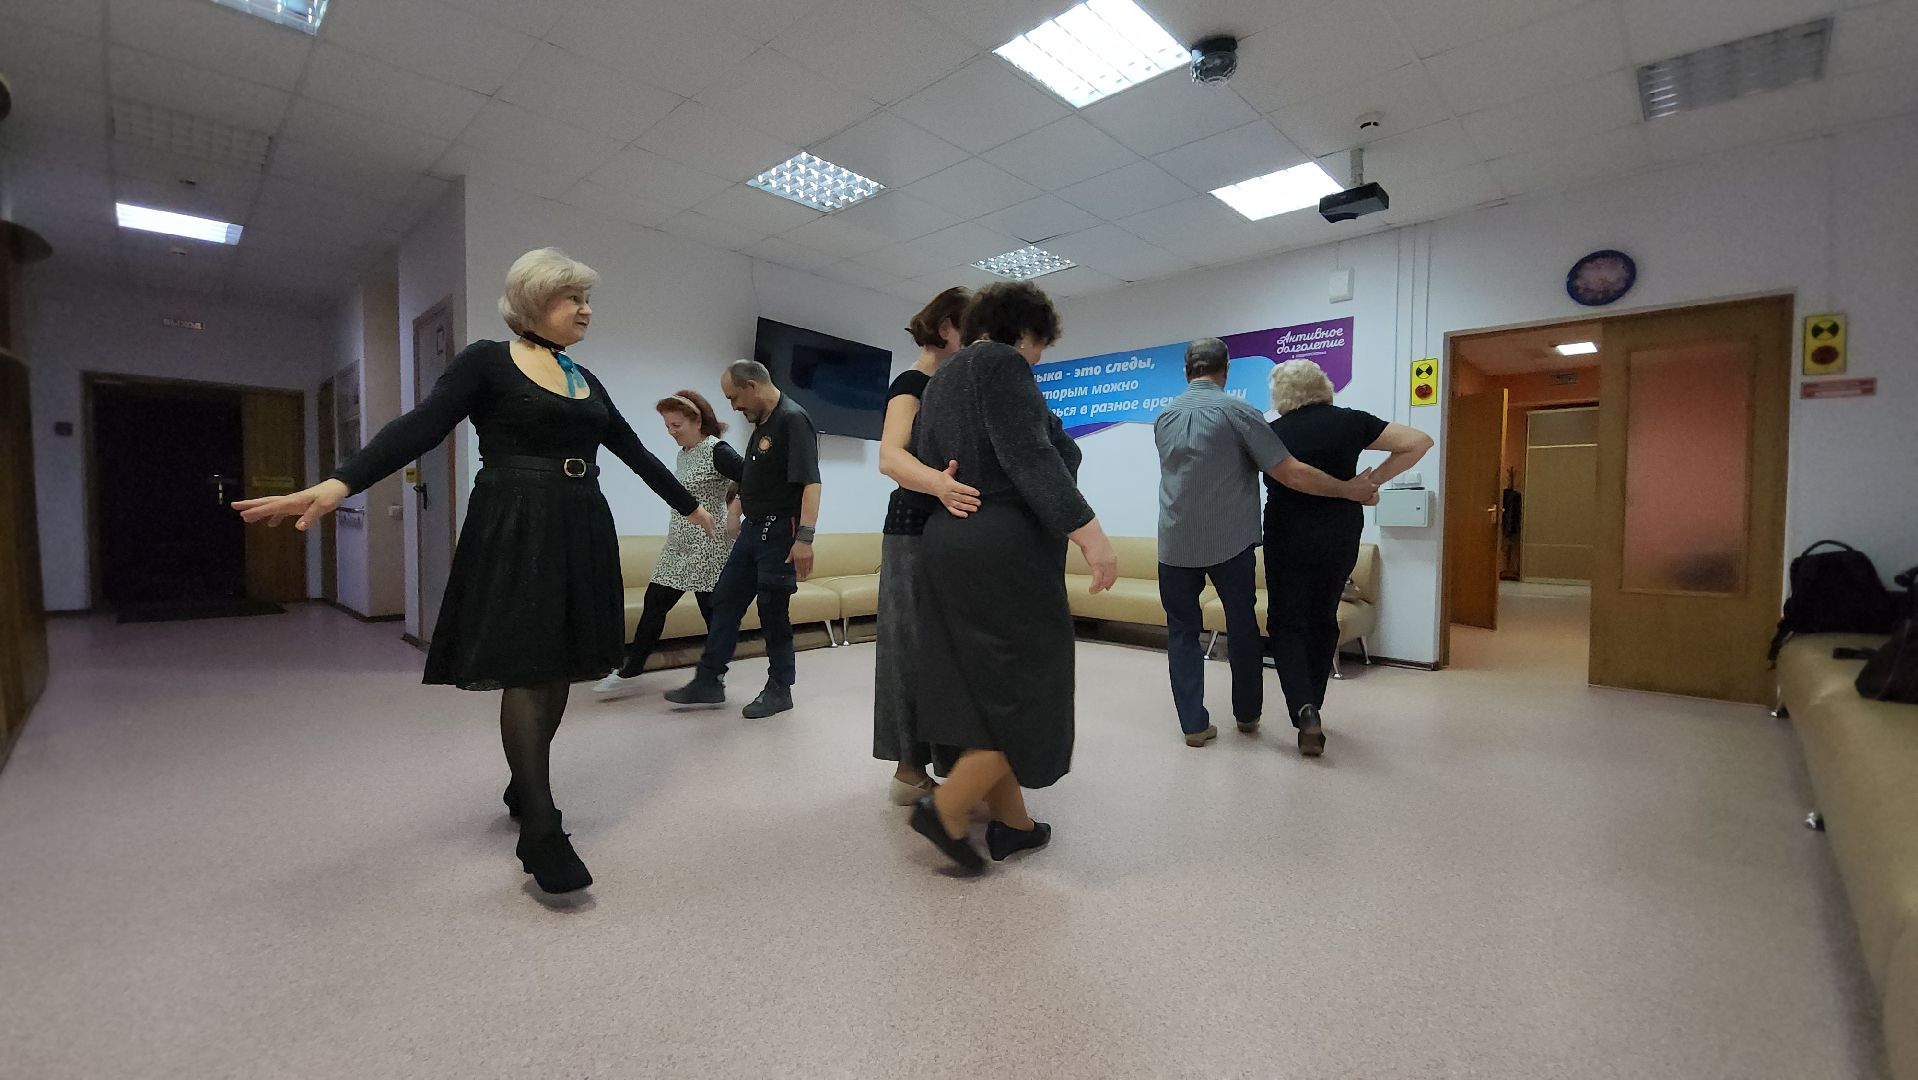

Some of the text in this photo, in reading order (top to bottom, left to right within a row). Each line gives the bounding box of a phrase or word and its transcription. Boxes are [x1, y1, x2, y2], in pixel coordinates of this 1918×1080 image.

[1276, 338, 1346, 355] долголетие
[1277, 327, 1344, 345] Активное
[1074, 366, 1102, 378] это
[1105, 356, 1155, 374] следы,
[1042, 380, 1139, 402] торым можно
[1080, 404, 1088, 415] в
[1090, 399, 1140, 418] разное
[1226, 388, 1248, 400] ни
